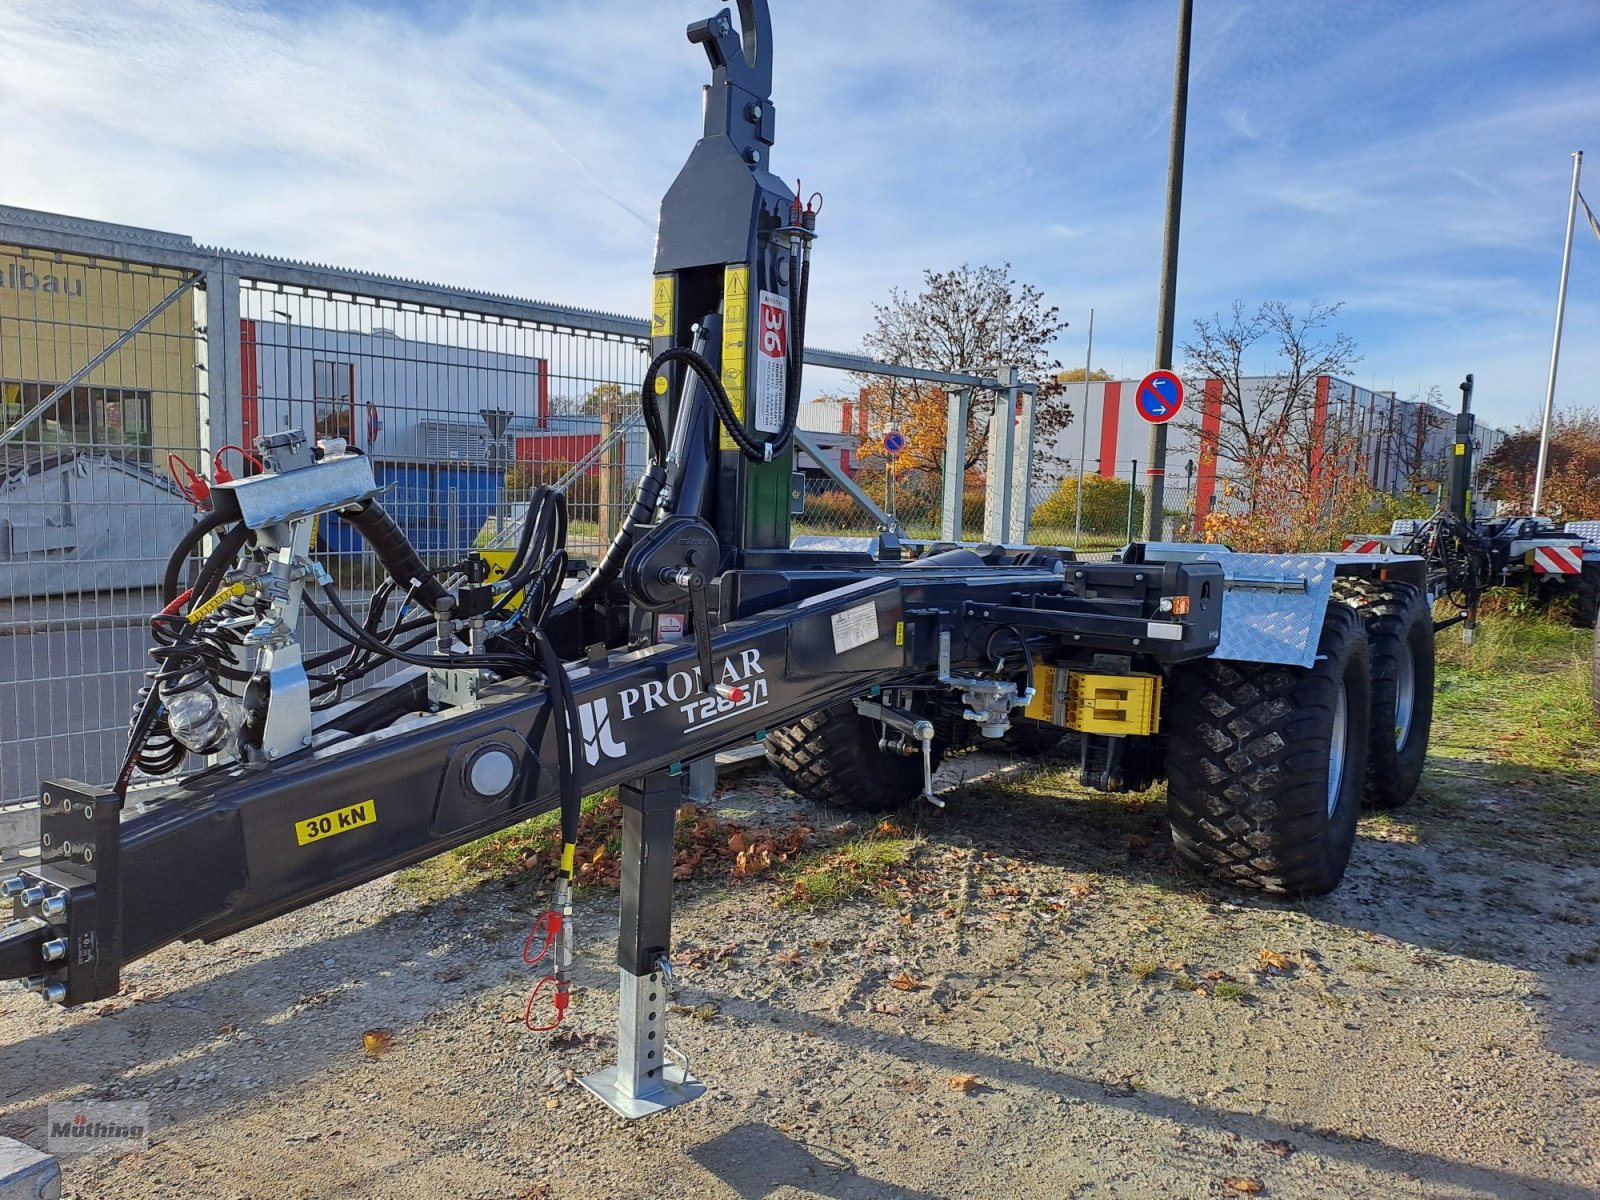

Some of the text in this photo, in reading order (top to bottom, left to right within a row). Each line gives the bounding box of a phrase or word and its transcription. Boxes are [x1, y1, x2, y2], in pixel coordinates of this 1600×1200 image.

[0, 263, 81, 297] lbau
[764, 308, 783, 352] 36
[306, 806, 366, 838] 30 kN
